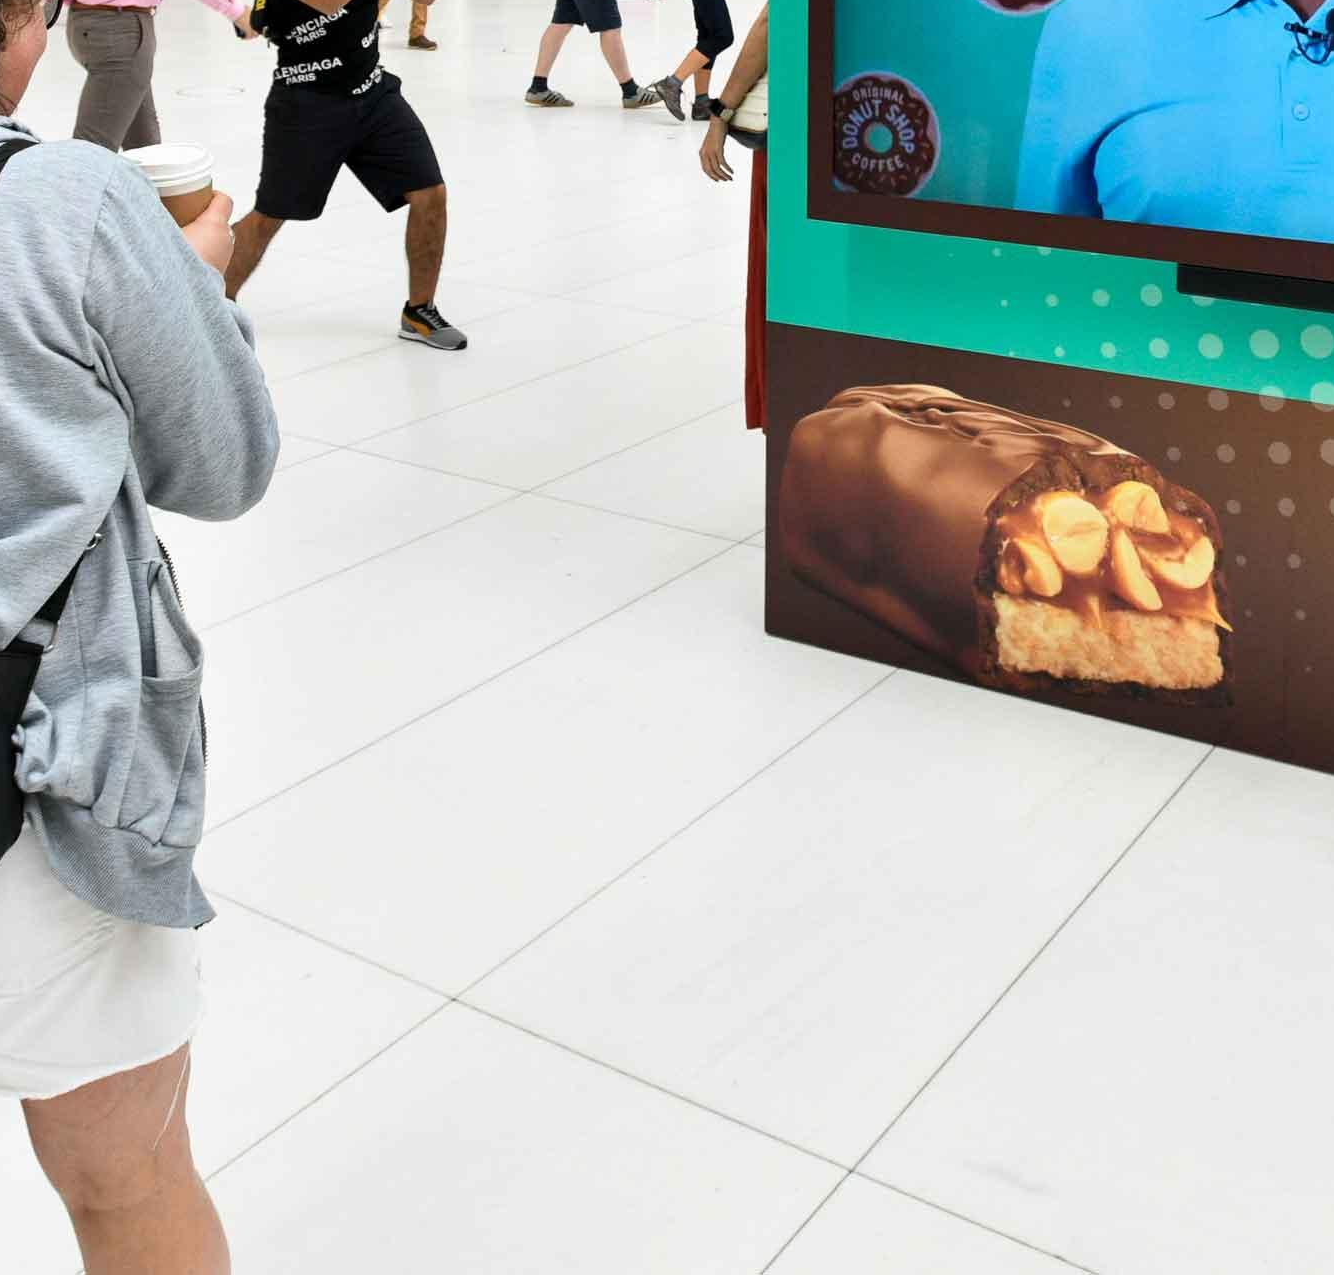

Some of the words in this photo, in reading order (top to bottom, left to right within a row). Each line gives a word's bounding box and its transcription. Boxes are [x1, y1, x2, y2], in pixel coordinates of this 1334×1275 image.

[296, 27, 327, 45] PARIS
[851, 87, 905, 104] ORIGINAL
[842, 99, 883, 150] DONUT
[885, 104, 916, 154] SHOP
[851, 153, 905, 173] COFFEE
